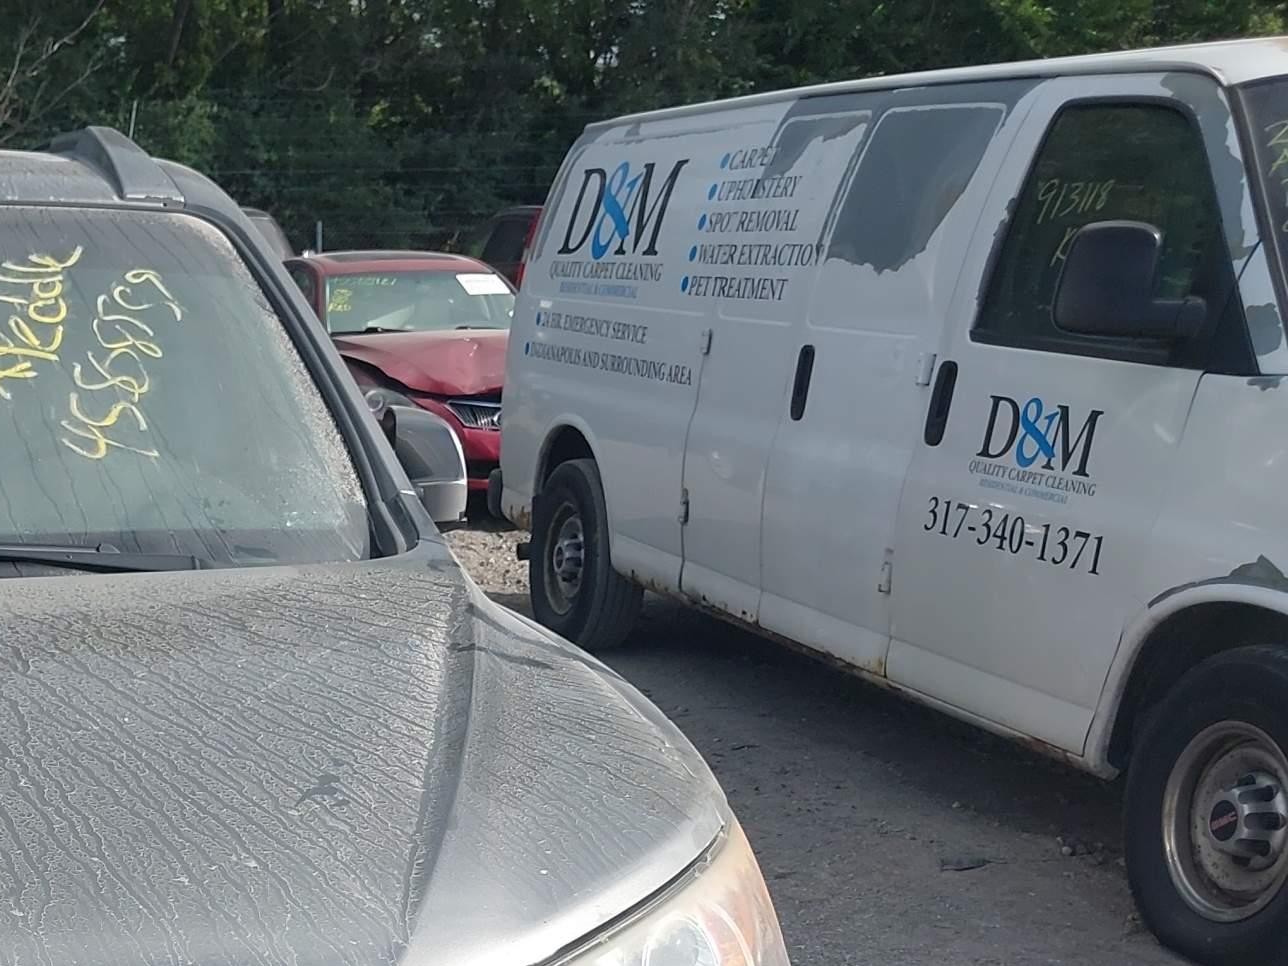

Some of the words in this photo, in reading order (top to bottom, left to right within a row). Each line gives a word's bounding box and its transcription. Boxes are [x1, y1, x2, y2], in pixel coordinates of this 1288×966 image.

[729, 147, 779, 170] CARPET
[718, 175, 802, 201] UPHOLSTERY
[557, 158, 690, 260] D&M
[706, 211, 738, 232] SPOT
[737, 209, 799, 232] REMOVAL
[698, 244, 737, 264] WATER
[736, 244, 820, 266] EXTRACTION
[549, 261, 584, 280] QUALITY
[583, 261, 617, 279] CARPET
[615, 262, 664, 282] CLEANING
[688, 276, 712, 297] PET
[710, 277, 789, 301] TREATMENT
[563, 314, 612, 338] EMERGENCY
[611, 321, 649, 345] SERVICE
[532, 341, 581, 366] INDIANAPOLIS
[582, 351, 600, 369] AND
[599, 352, 668, 381] SURROUNDING
[666, 365, 692, 386] AREA
[976, 395, 1105, 478] D&M
[968, 459, 1009, 480] QUALITY
[1008, 468, 1047, 487] CARPET
[1045, 475, 1097, 497] CLEANING
[924, 496, 1103, 575] 317-340-1371
